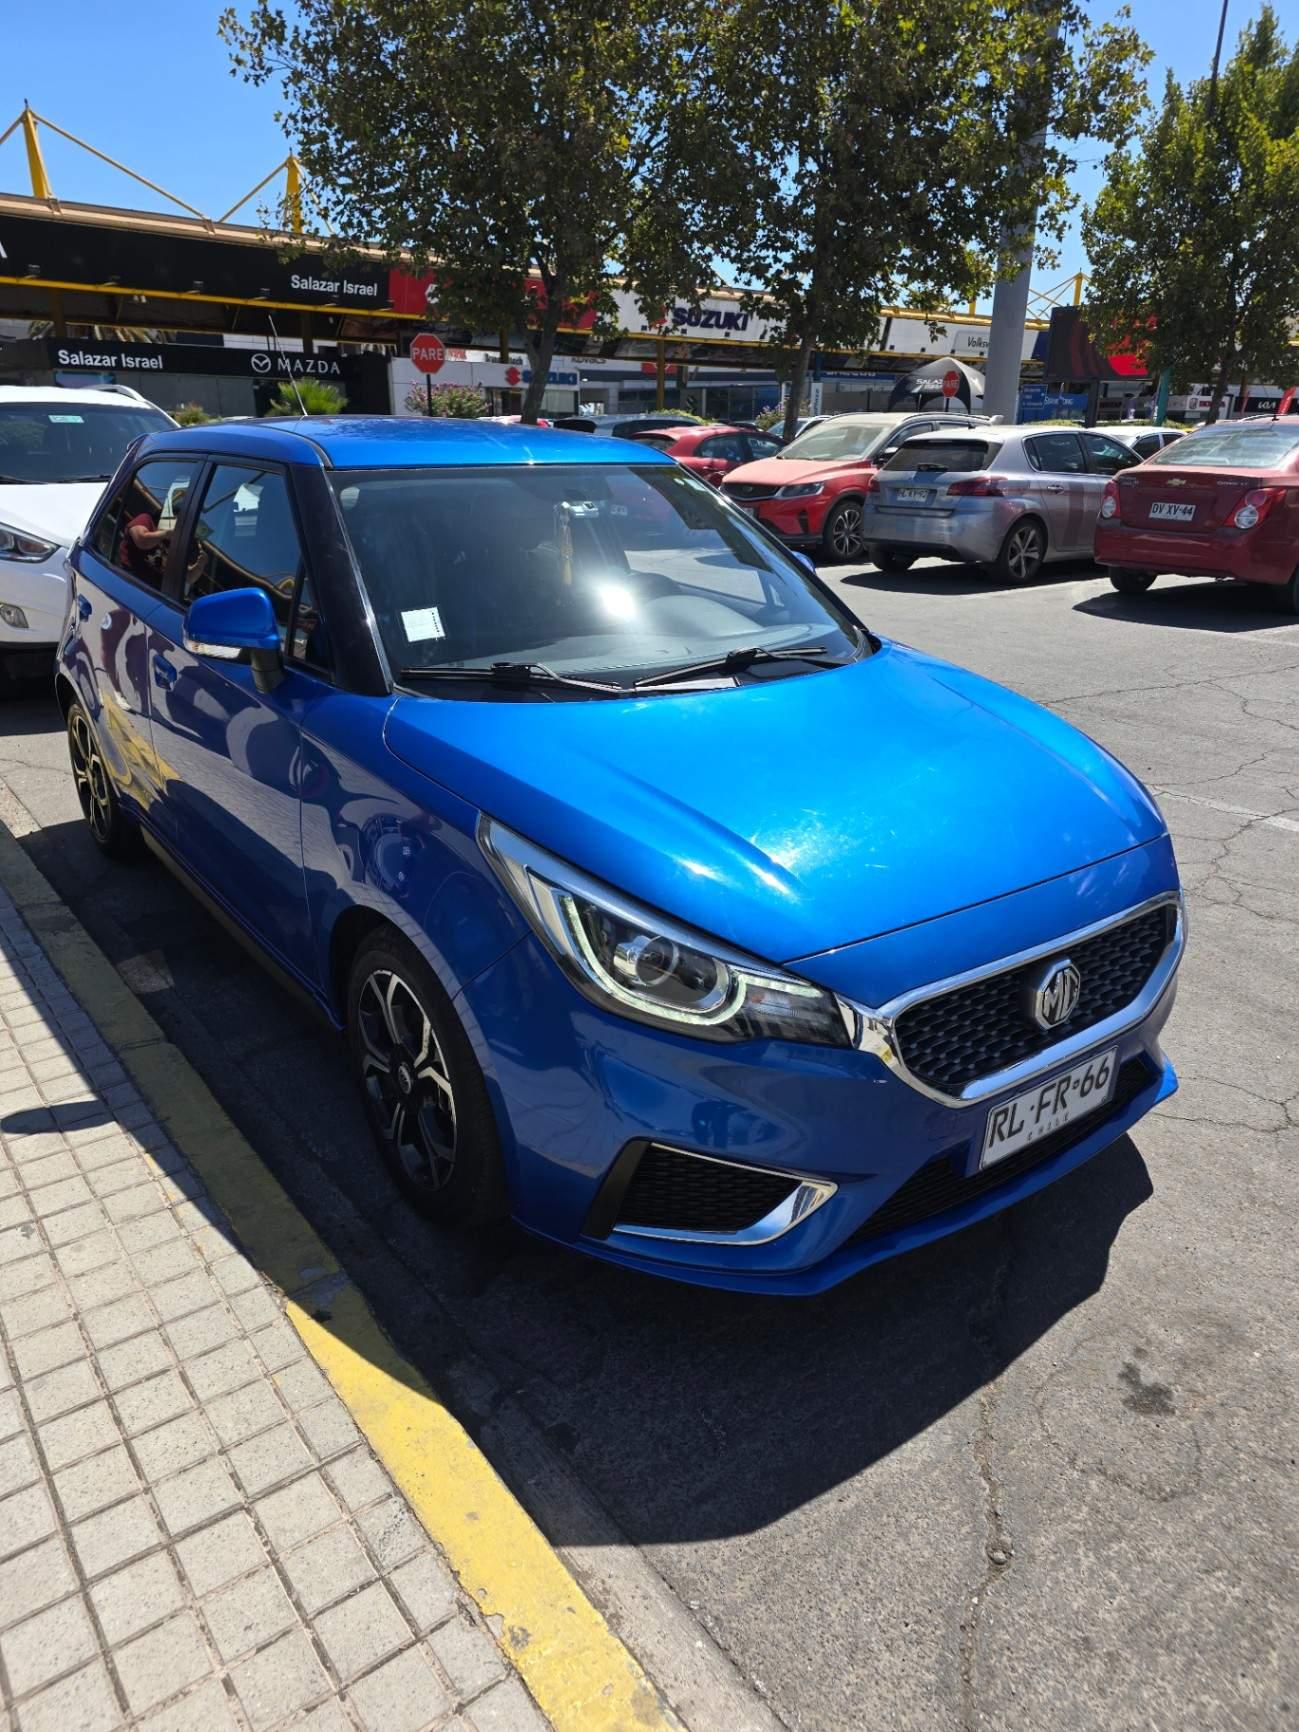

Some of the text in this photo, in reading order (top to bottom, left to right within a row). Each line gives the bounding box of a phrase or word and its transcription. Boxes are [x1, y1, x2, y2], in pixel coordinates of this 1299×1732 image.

[290, 274, 378, 297] Salazar Israel
[672, 307, 749, 331] SUZUKI
[58, 349, 163, 370] Salazar Israel
[411, 347, 444, 361] PARE
[277, 357, 341, 375] MAZDA
[1043, 968, 1081, 1025] MG
